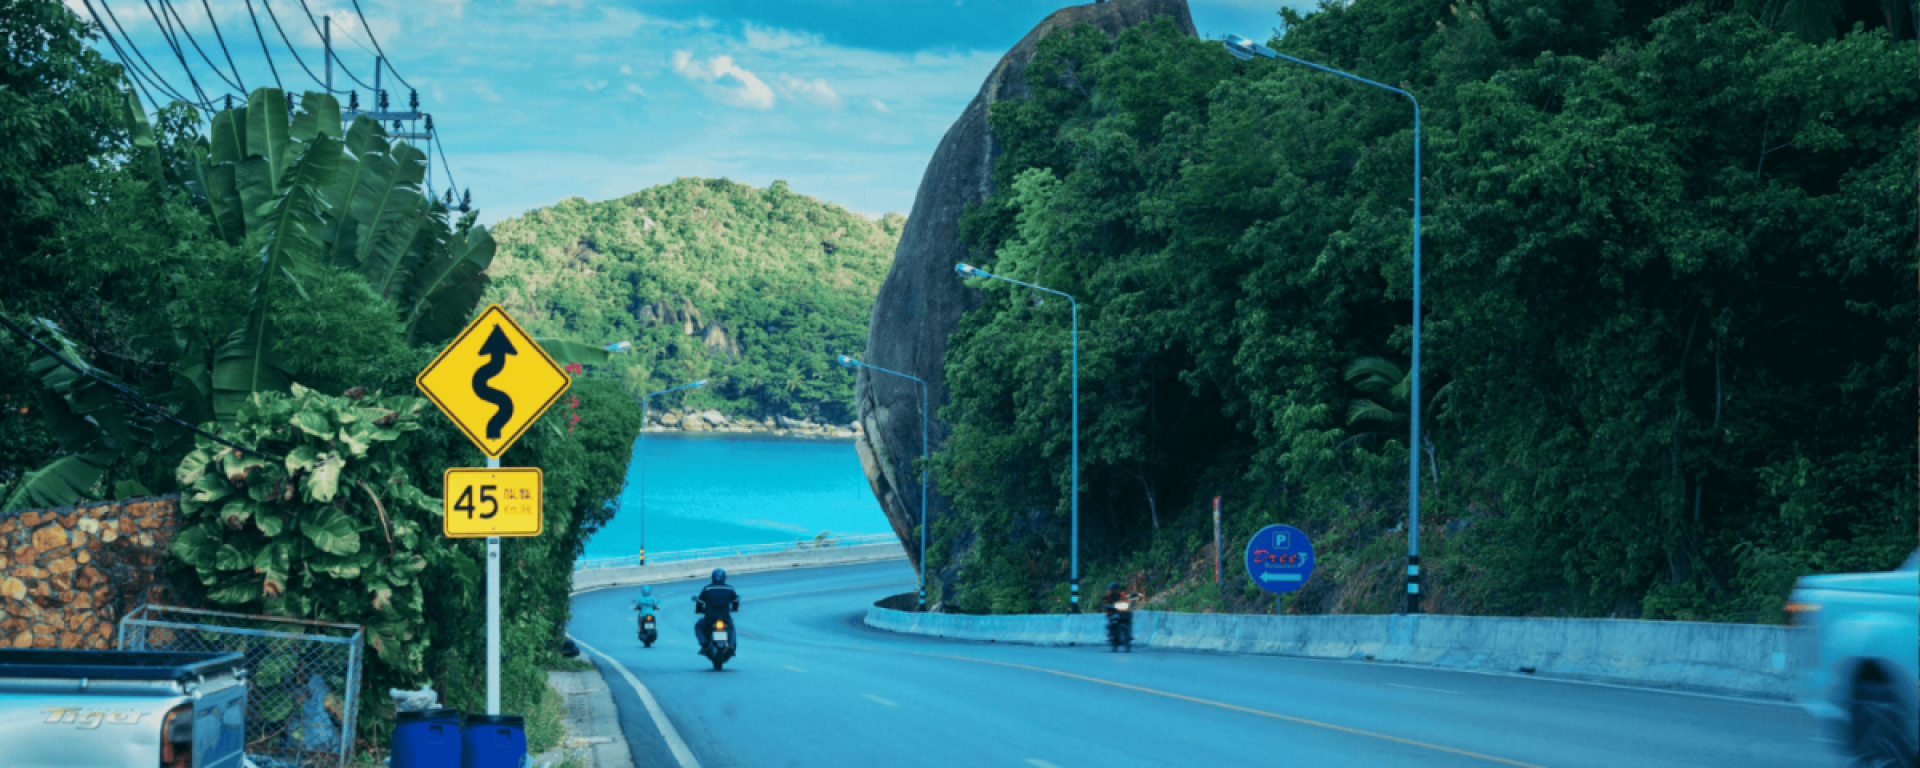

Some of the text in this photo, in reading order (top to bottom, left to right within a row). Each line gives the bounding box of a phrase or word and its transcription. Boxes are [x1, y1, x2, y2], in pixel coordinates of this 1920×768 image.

[453, 484, 498, 520] 45
[1276, 533, 1286, 547] P
[42, 706, 151, 730] Tiger
